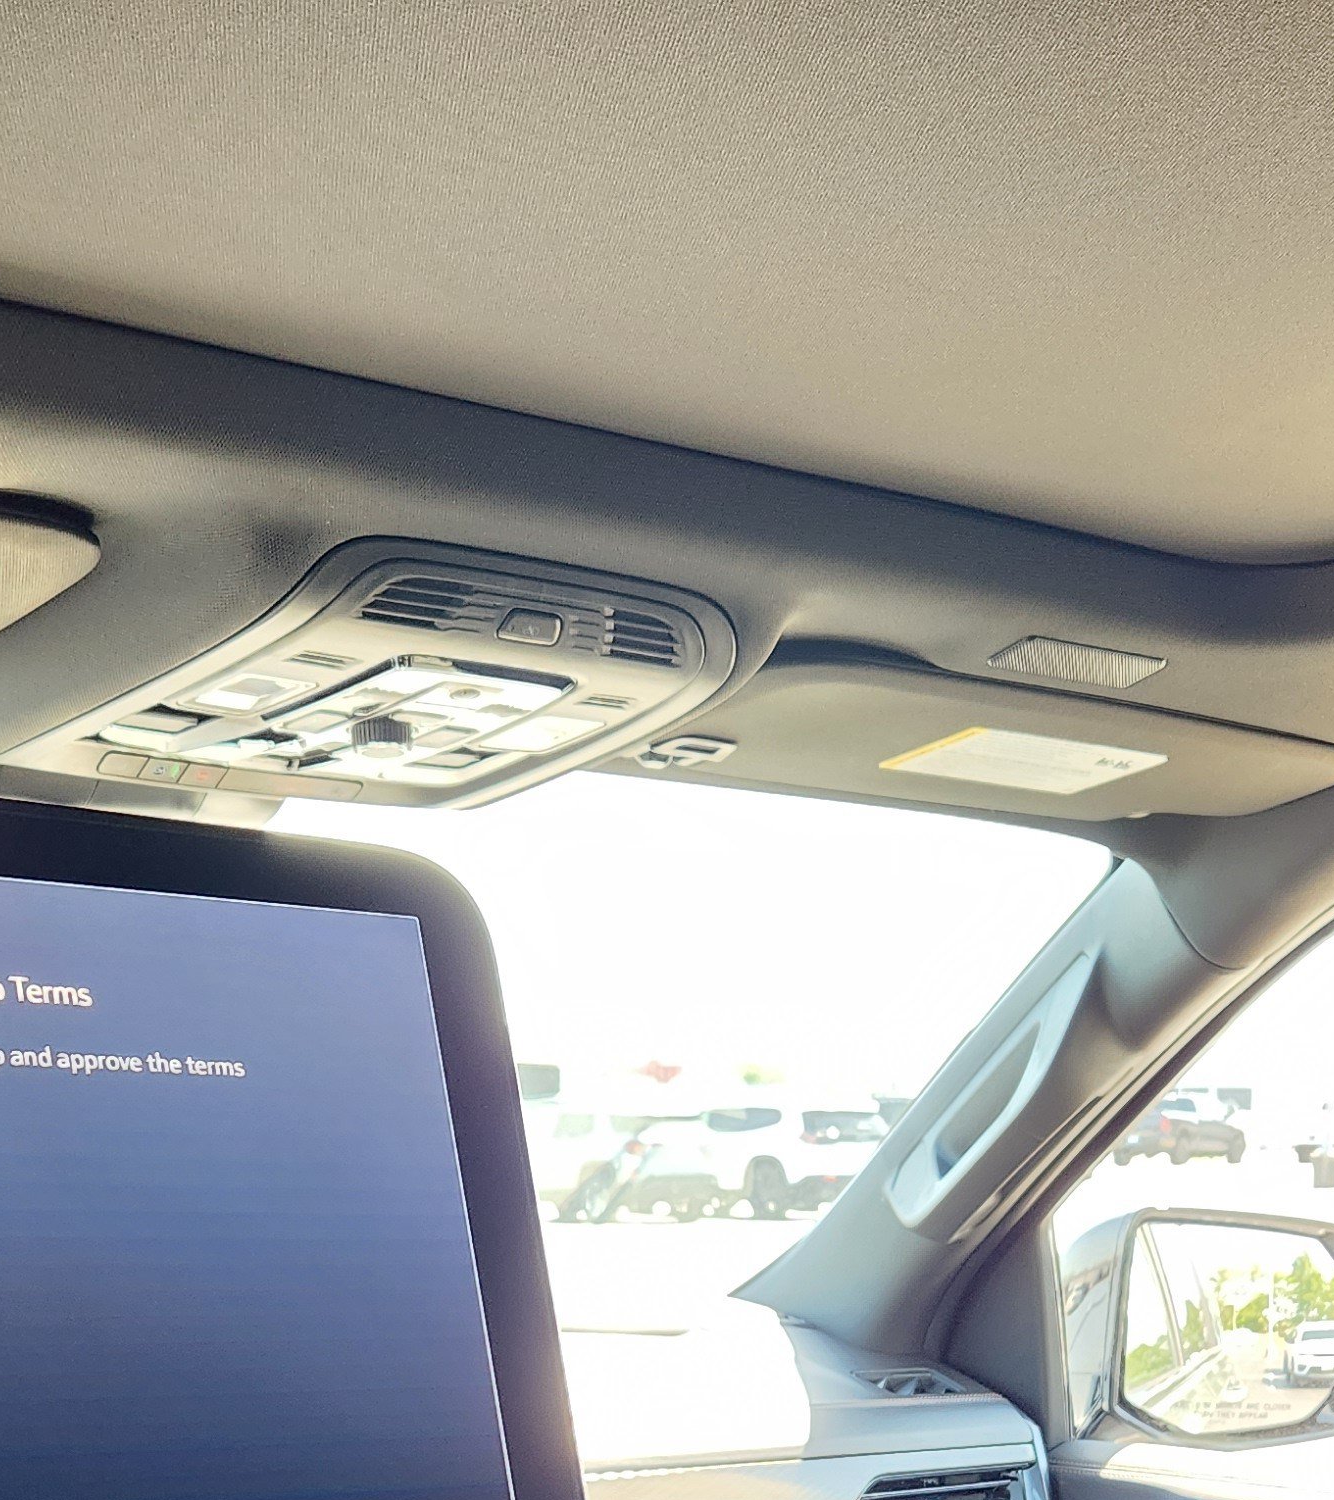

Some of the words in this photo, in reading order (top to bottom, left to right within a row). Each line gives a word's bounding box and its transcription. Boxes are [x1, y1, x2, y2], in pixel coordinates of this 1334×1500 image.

[8, 975, 93, 1008] Terms
[9, 1045, 53, 1068] and
[56, 1052, 143, 1075] approve
[146, 1052, 182, 1075] the
[185, 1056, 246, 1078] terms
[1263, 1402, 1292, 1411] CLOSER
